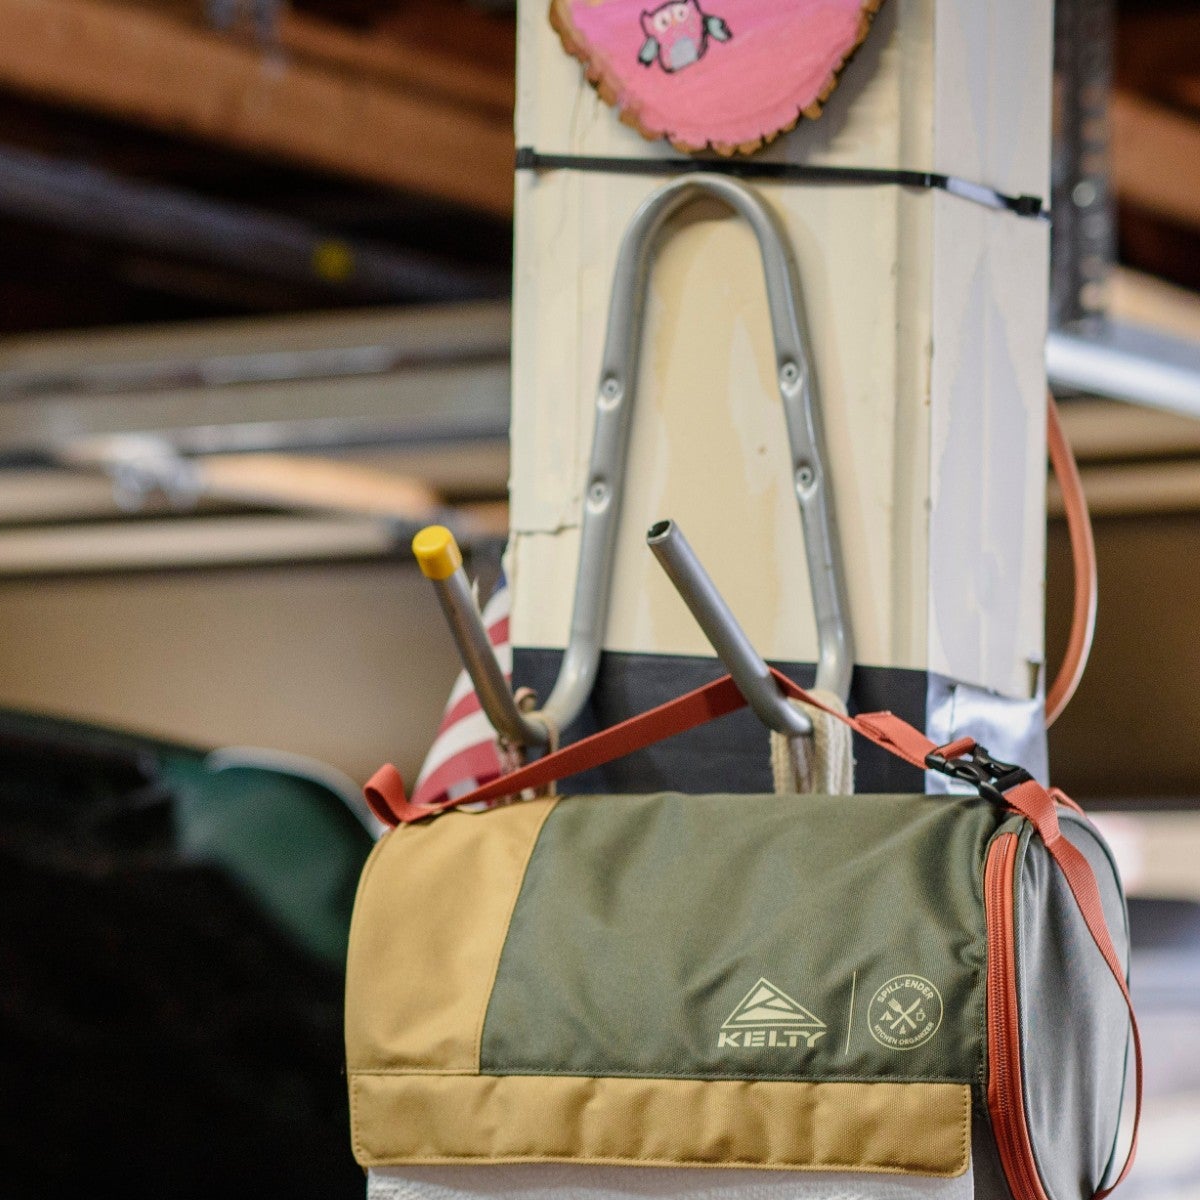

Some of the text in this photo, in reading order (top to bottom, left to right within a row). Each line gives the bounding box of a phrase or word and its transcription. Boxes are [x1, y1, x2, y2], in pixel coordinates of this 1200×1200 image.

[877, 979, 934, 1003] SPILL-ENDER
[718, 1030, 827, 1048] KELTY
[874, 1021, 935, 1045] KITCHEN ORGANIZER
